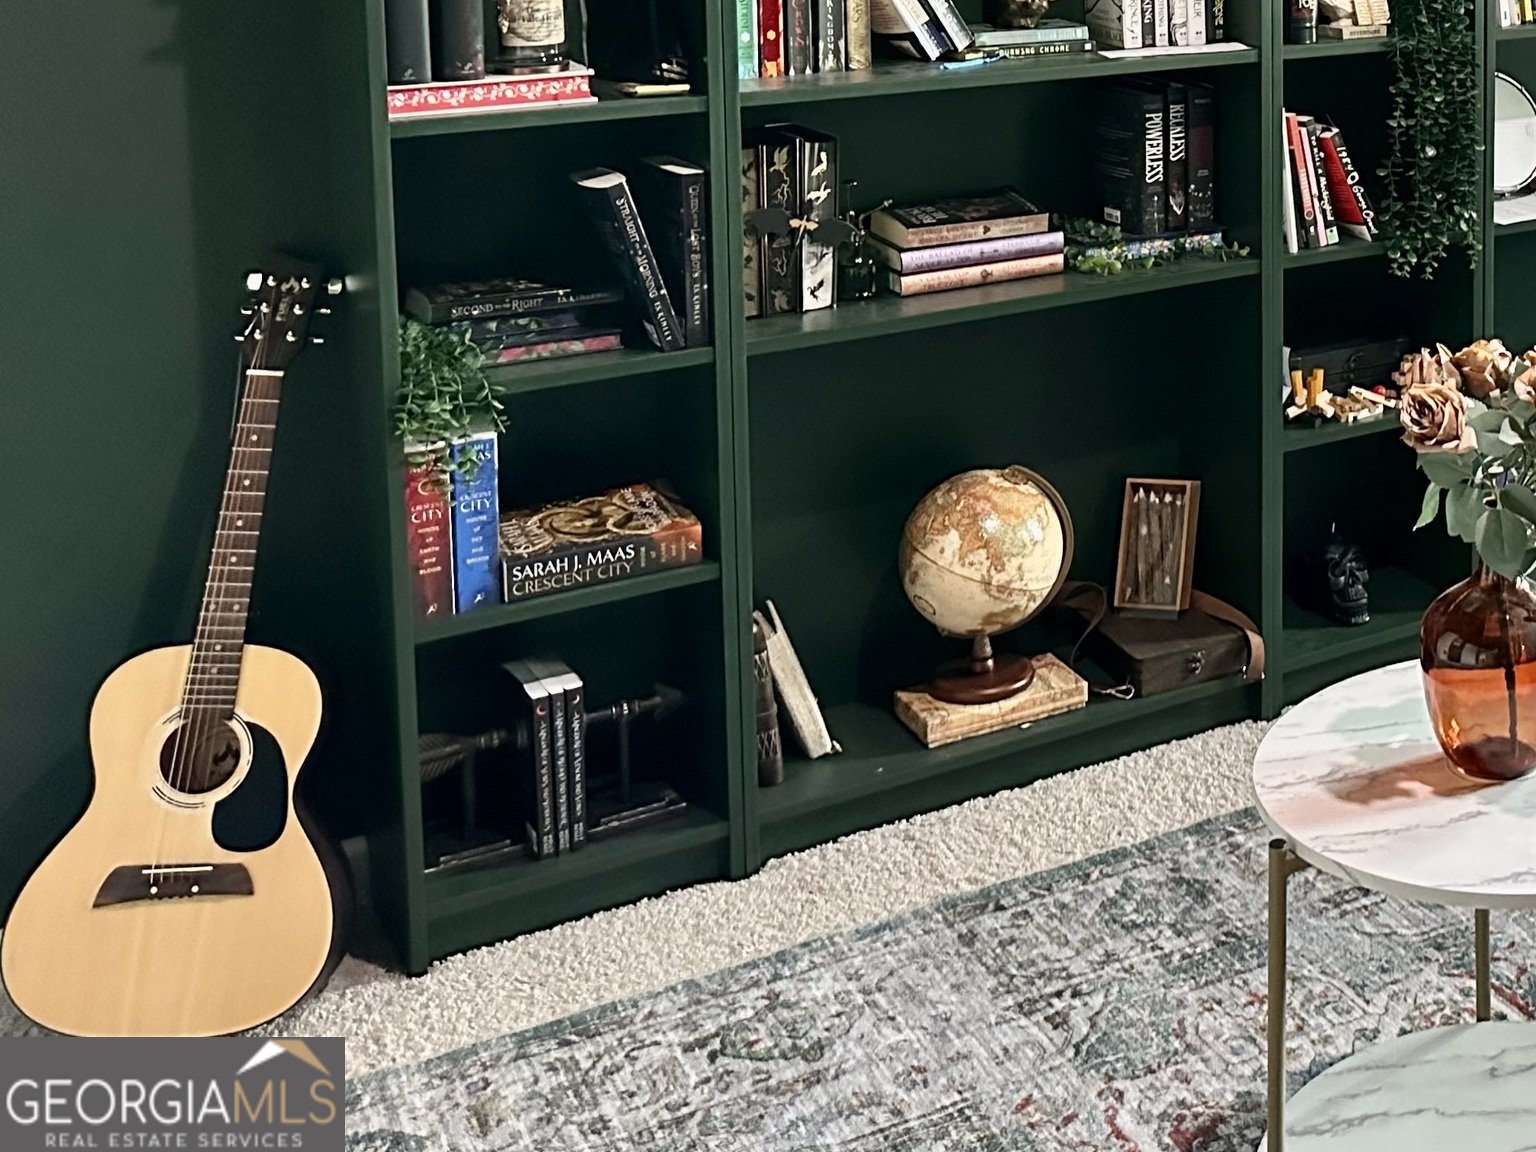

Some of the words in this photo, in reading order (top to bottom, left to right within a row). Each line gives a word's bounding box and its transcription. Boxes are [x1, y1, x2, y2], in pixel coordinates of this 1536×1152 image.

[1039, 44, 1070, 54] CHROME
[1170, 104, 1186, 162] RECKLESS
[1310, 135, 1317, 145] TO
[1146, 112, 1164, 184] POWERLESS
[1312, 146, 1321, 166] KILL
[1336, 146, 1354, 172] 1984
[688, 184, 700, 213] QUEEN
[1352, 185, 1367, 210] George
[616, 197, 640, 243] STRAIGHT
[636, 253, 658, 298] MORNING
[690, 227, 701, 250] LOST
[450, 303, 494, 317] SECOND
[511, 297, 544, 312] RIGHT
[411, 510, 444, 524] CITY
[460, 499, 492, 513] CITY
[419, 566, 442, 576] BLOOD
[512, 558, 568, 582] SARAH
[574, 556, 582, 570] J.
[586, 544, 636, 567] MAAS
[512, 572, 591, 597] CRESCENT
[598, 562, 634, 580] CITY
